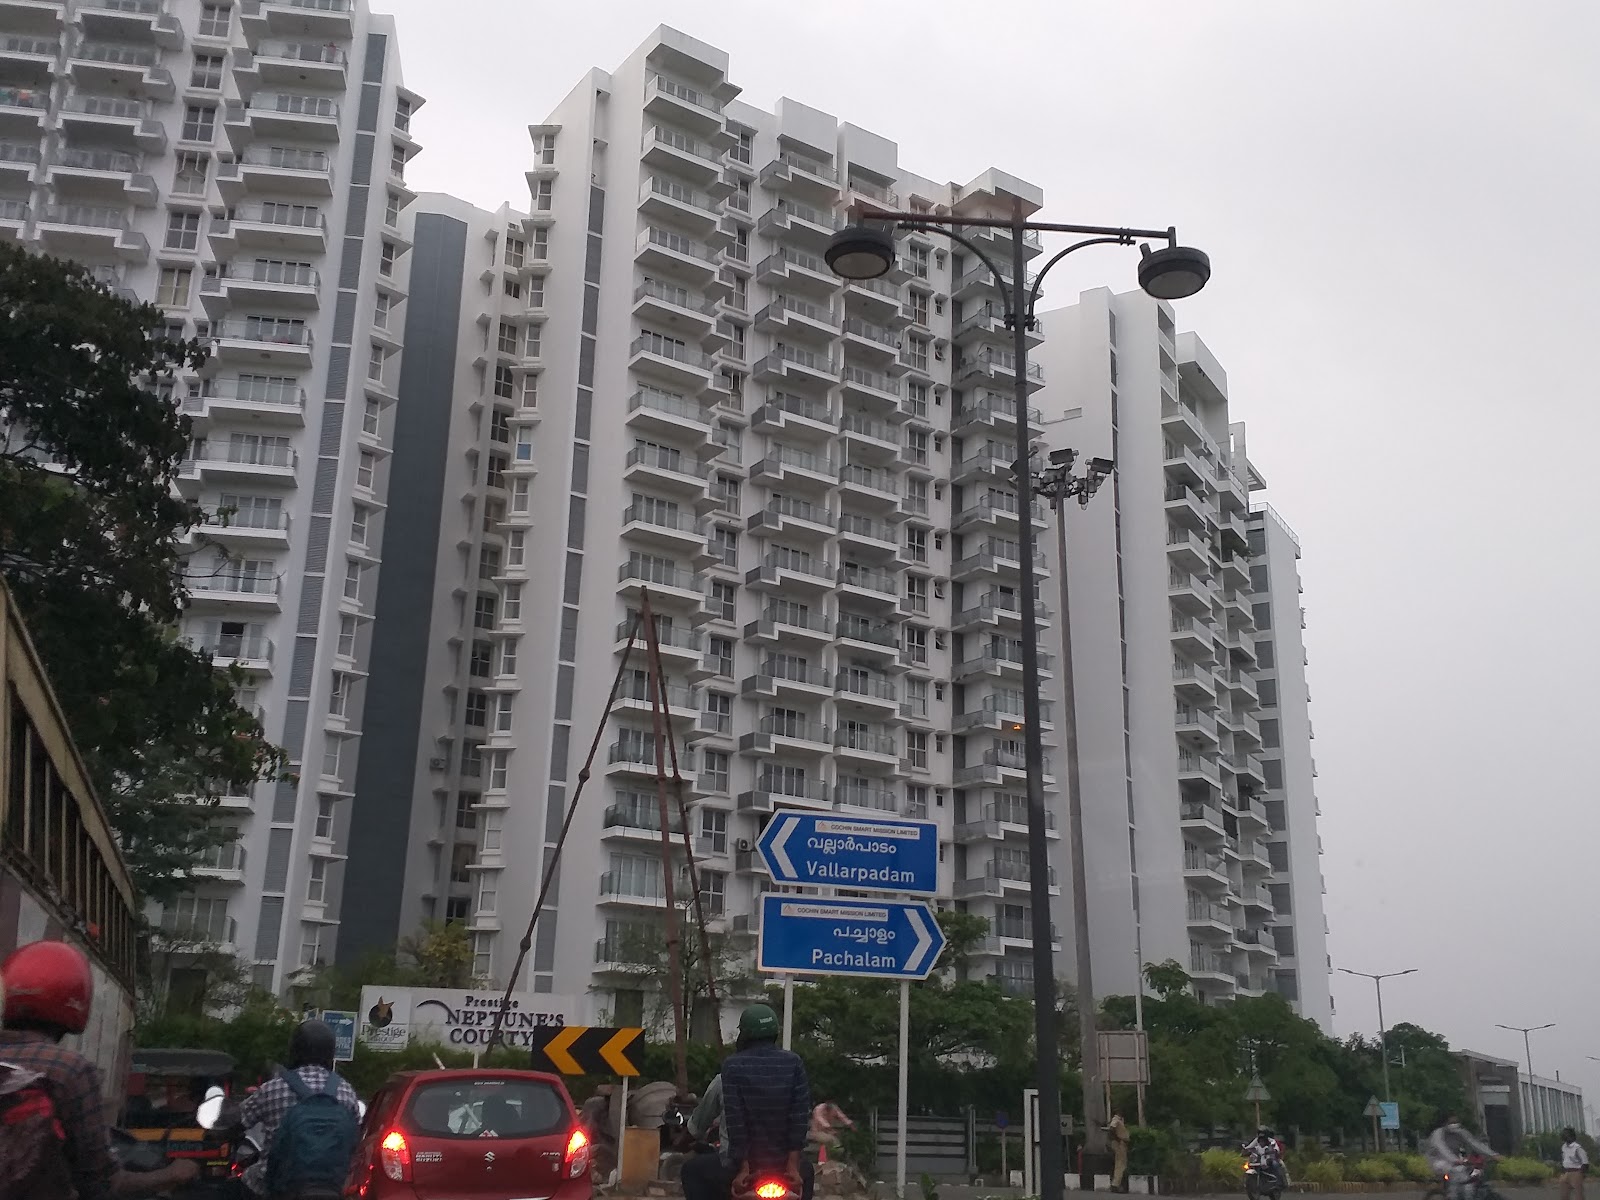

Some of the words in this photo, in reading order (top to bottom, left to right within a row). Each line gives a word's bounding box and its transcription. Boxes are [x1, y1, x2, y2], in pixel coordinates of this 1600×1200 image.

[873, 827, 895, 835] MISSION
[806, 860, 915, 883] Vallarpadam
[833, 926, 896, 945] പച്ചാളം
[812, 948, 896, 968] Pachalam
